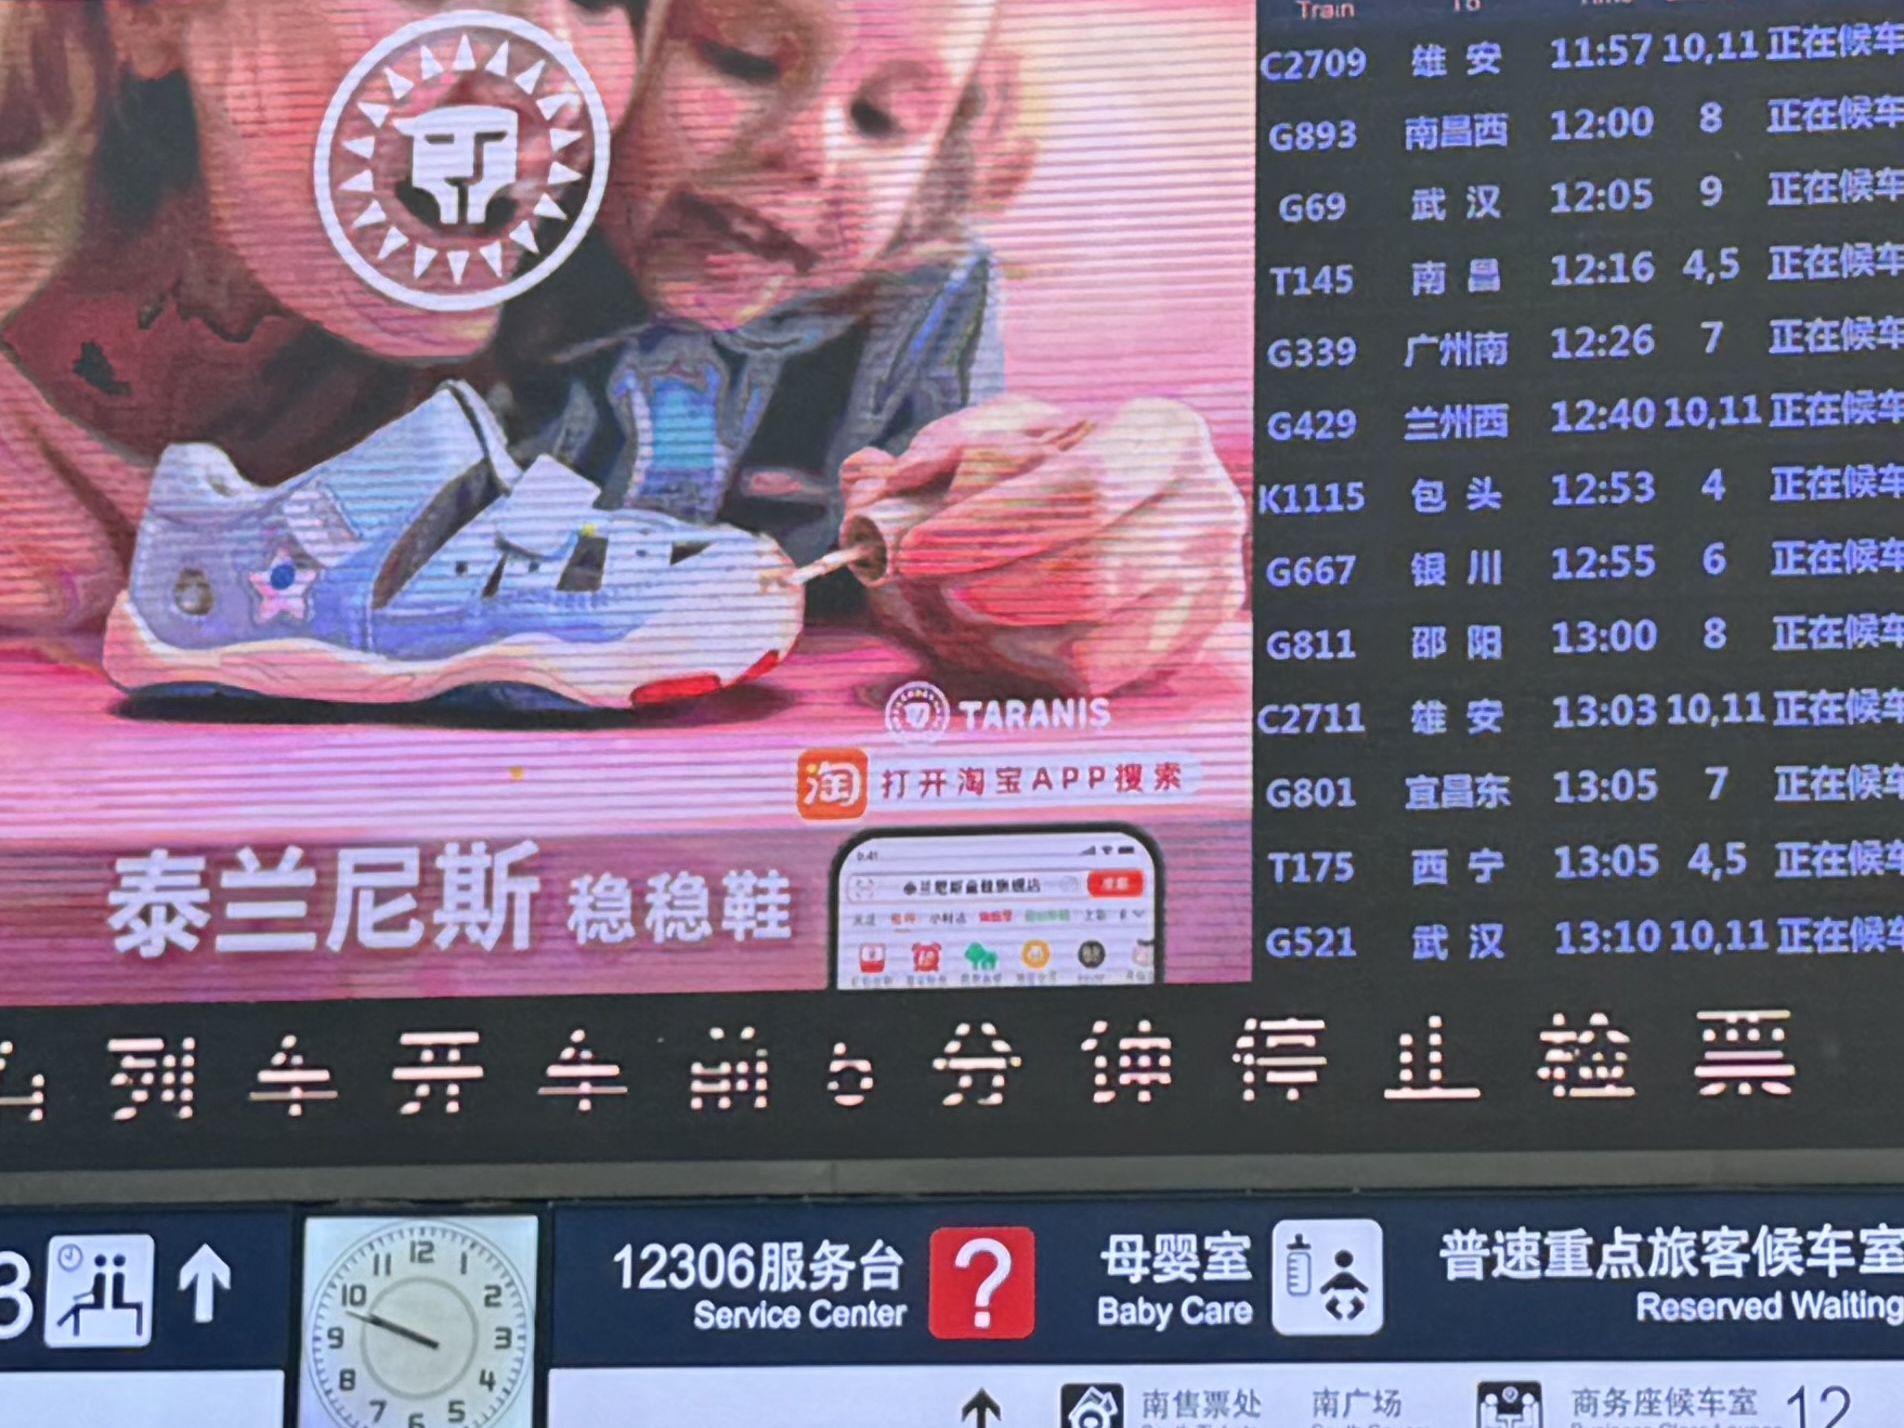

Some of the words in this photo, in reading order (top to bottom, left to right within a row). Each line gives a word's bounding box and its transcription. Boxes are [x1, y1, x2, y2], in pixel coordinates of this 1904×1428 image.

[1269, 120, 1356, 151] G893
[1552, 106, 1654, 140] 12:00
[1700, 102, 1722, 133] 8
[959, 698, 1111, 731] TARANIS
[805, 761, 860, 806] 淘
[882, 762, 1183, 799] 打开淘宝APP搜索
[1267, 778, 1356, 808] G801
[1554, 769, 1658, 803] 13:05
[1705, 767, 1728, 799] 7
[108, 838, 541, 958] 泰兰尼斯
[567, 868, 794, 945] 稳稳鞋
[374, 1254, 391, 1276] 11
[410, 1241, 434, 1263] 12
[461, 1252, 467, 1275] 1
[614, 1239, 903, 1292] 12306服务台
[1101, 1230, 1252, 1283] 母婴室
[342, 1285, 366, 1307] 10
[485, 1285, 501, 1307] 2
[1637, 1291, 1782, 1321] Reserved
[1791, 1290, 1904, 1326] Waiting
[694, 1300, 801, 1329] Service
[809, 1299, 907, 1328] Center
[1098, 1297, 1173, 1332] Baby
[1181, 1296, 1253, 1325] Care
[328, 1327, 344, 1349] 9
[495, 1327, 512, 1349] 3
[339, 1369, 355, 1391] 8
[480, 1370, 495, 1391] 4
[370, 1401, 386, 1422] 7
[449, 1401, 465, 1422] 5
[1143, 1389, 1261, 1420] 南售票处
[1313, 1388, 1401, 1418] 南广场
[1573, 1387, 1757, 1417] 商务座候车室
